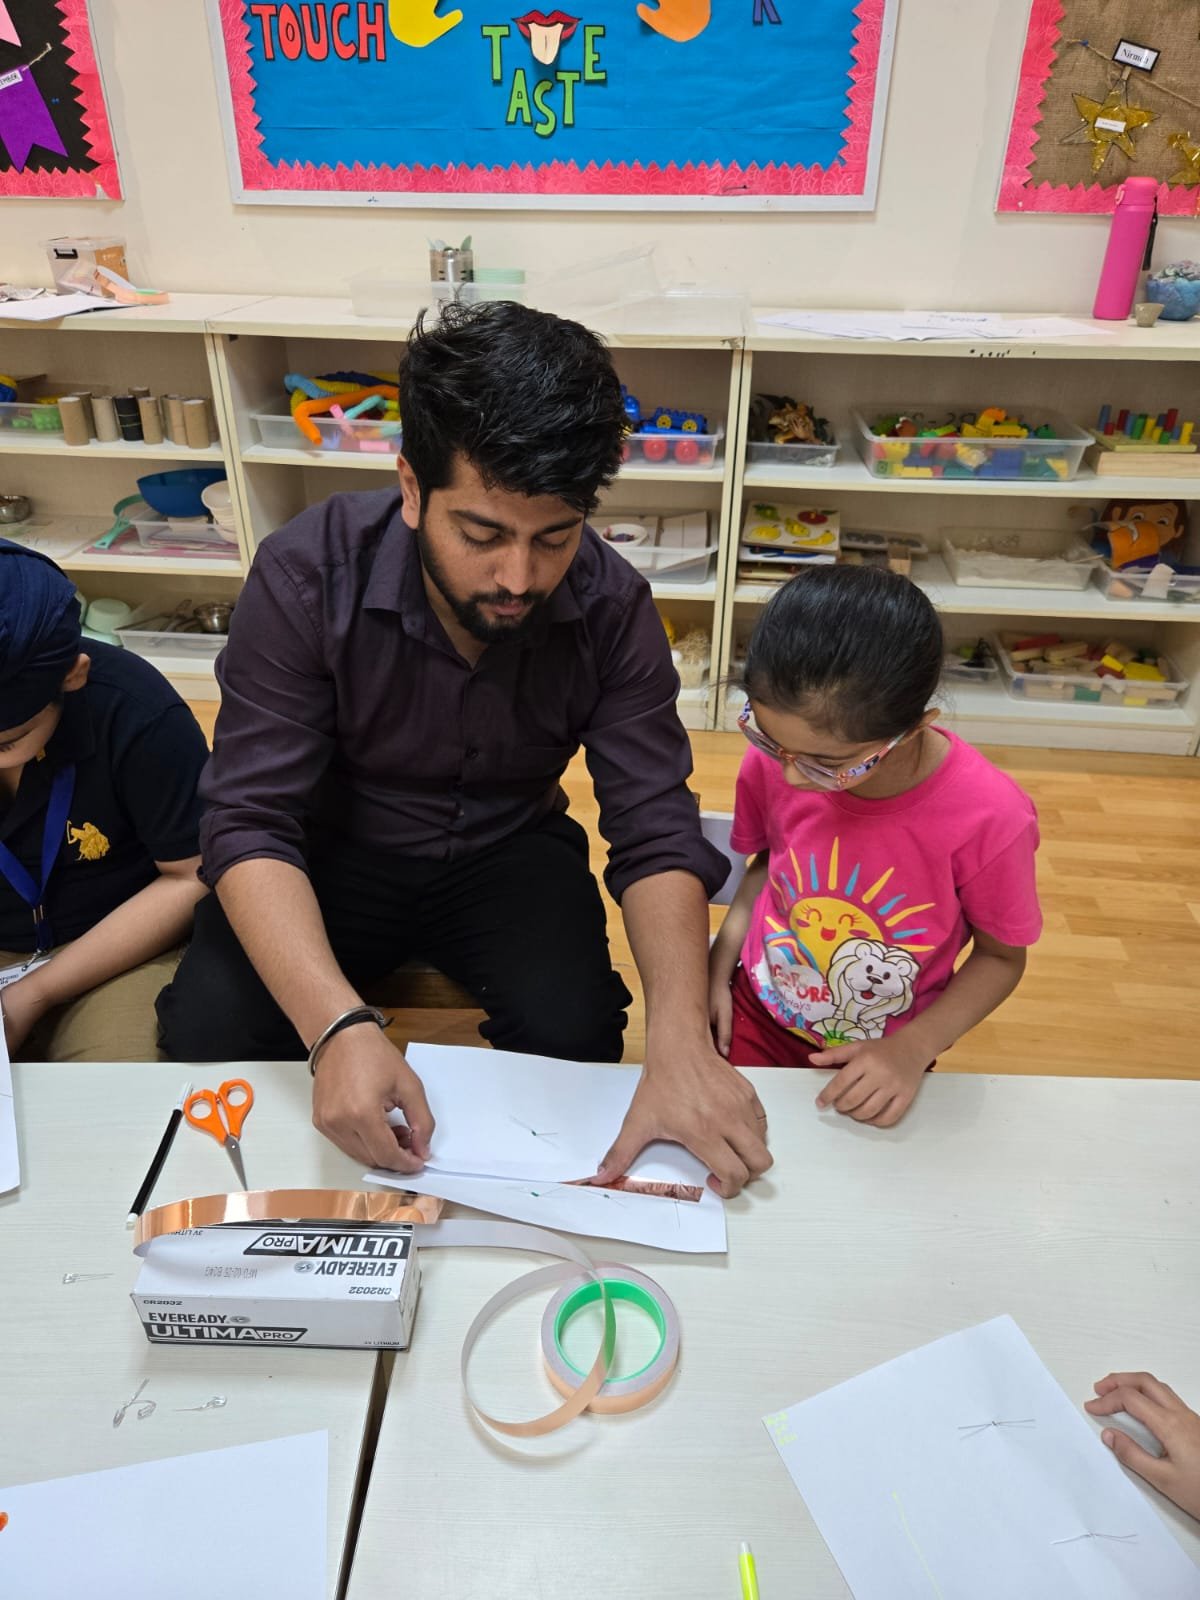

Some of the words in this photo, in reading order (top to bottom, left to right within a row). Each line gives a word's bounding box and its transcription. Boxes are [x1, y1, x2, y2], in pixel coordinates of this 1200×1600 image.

[251, 2, 387, 62] TOUCH
[262, 1236, 295, 1248] PRO
[298, 1235, 404, 1257] ULTIMA
[315, 1260, 397, 1277] EVEREADY
[349, 1285, 392, 1295] CR2032
[148, 1312, 228, 1324] EVEREADY
[151, 1324, 261, 1339] ULTIMA
